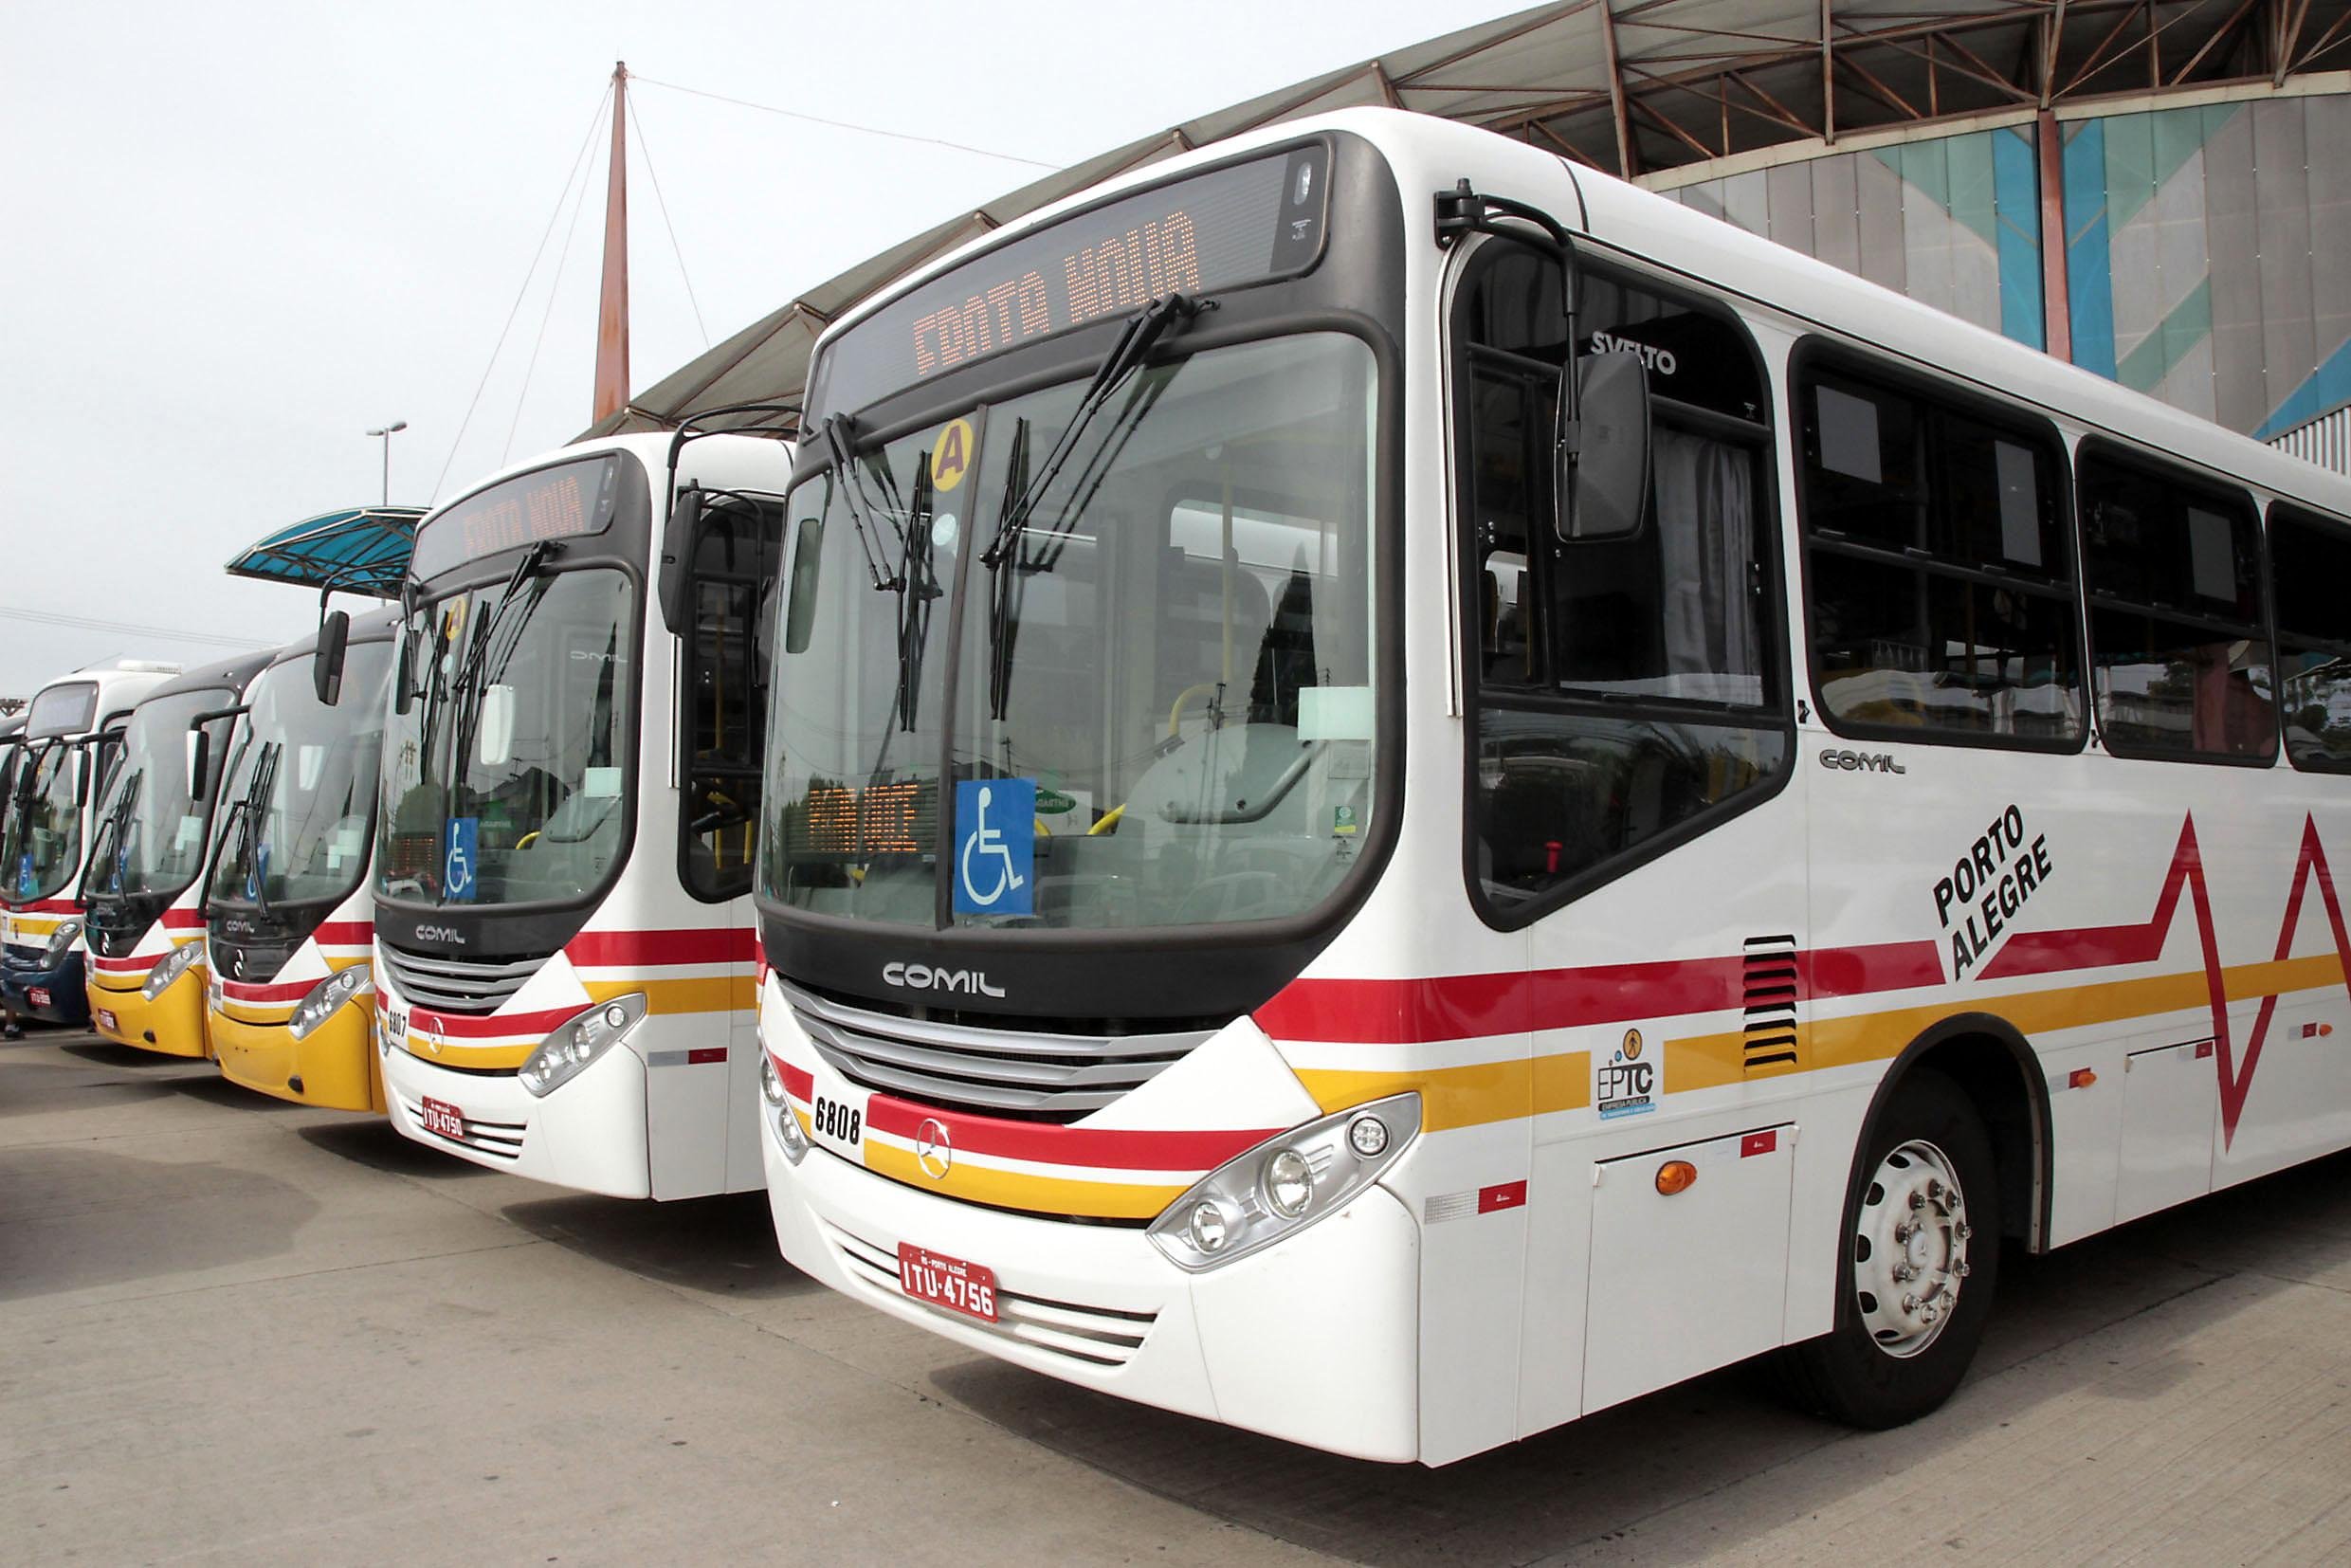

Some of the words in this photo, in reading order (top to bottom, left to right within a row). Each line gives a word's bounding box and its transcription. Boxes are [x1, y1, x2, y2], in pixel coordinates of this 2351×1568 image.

[1064, 210, 1200, 324] NOVA
[935, 424, 964, 480] A
[1819, 749, 1905, 774] COMIL
[1933, 804, 2024, 929] PORTO
[1952, 833, 2052, 983] ALEGRE
[415, 924, 465, 944] COMIL
[883, 961, 1005, 998] COMIL
[1598, 1062, 1653, 1101] EPTC
[815, 1096, 861, 1145] 6808
